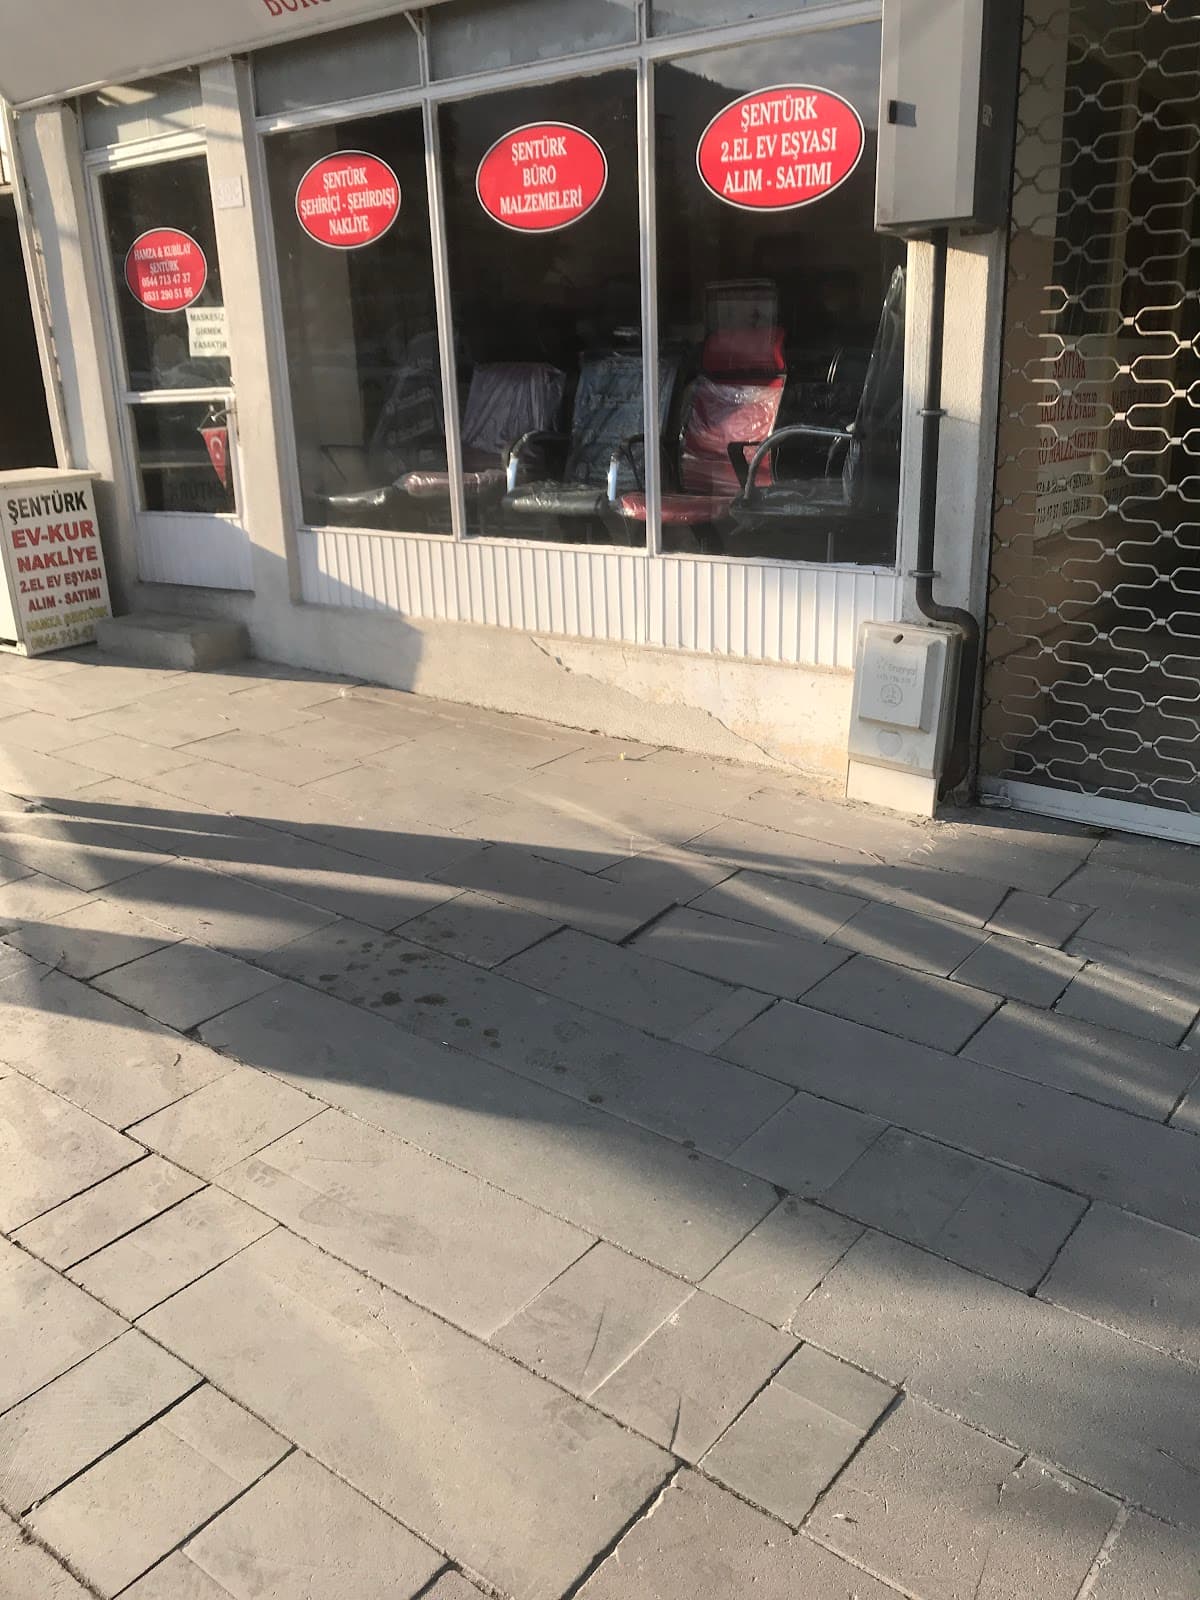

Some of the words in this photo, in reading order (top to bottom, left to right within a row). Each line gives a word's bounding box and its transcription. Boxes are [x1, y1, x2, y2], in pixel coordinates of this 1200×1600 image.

[741, 94, 818, 132] ŞENTÜRK
[511, 135, 567, 166] ŞENTÜRK
[720, 138, 752, 163] 2.EL
[756, 134, 778, 159] EV
[781, 127, 838, 160] EŞYASI
[323, 166, 368, 193] ŞENTÜRK
[523, 164, 557, 187] BÜRO
[723, 168, 763, 194] ALIM
[776, 161, 832, 189] SATIMI
[500, 184, 583, 215] MALZEMELERİ
[328, 214, 370, 236] NAKLİYE
[134, 246, 157, 260] HAMZA
[159, 274, 171, 285] 713
[172, 273, 180, 284] 47
[182, 272, 191, 283] 37
[7, 489, 88, 525] ŞENTÜRK
[11, 519, 96, 549] EV-KUR
[17, 546, 98, 573] NAKLİYE
[20, 578, 45, 593] 2.EL
[46, 575, 61, 588] EV
[64, 567, 102, 587] EŞYASI
[28, 595, 56, 612] ALIM
[65, 587, 101, 605] SATIMI
